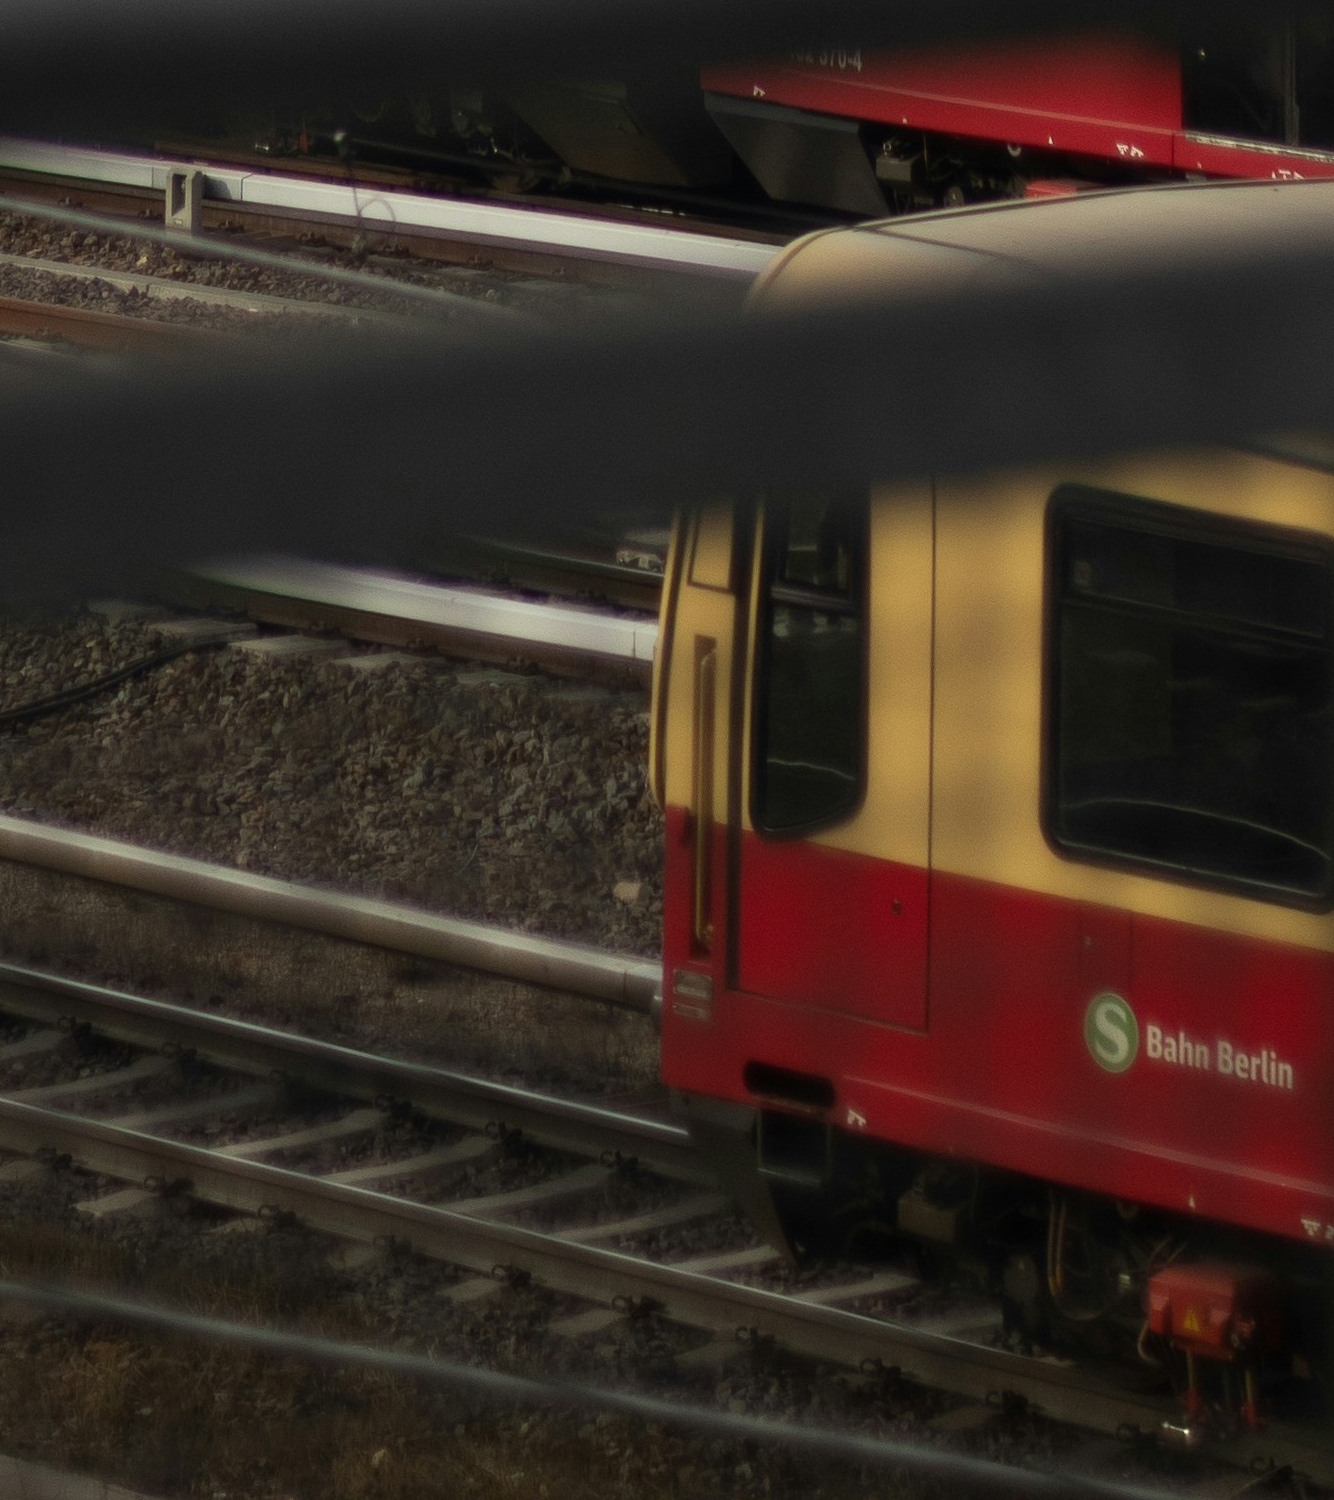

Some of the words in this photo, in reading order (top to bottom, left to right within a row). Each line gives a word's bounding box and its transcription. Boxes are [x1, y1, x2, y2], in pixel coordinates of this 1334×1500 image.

[1093, 1001, 1130, 1065] S
[1146, 1023, 1210, 1071] Bahn
[1217, 1040, 1294, 1090] Berlin
